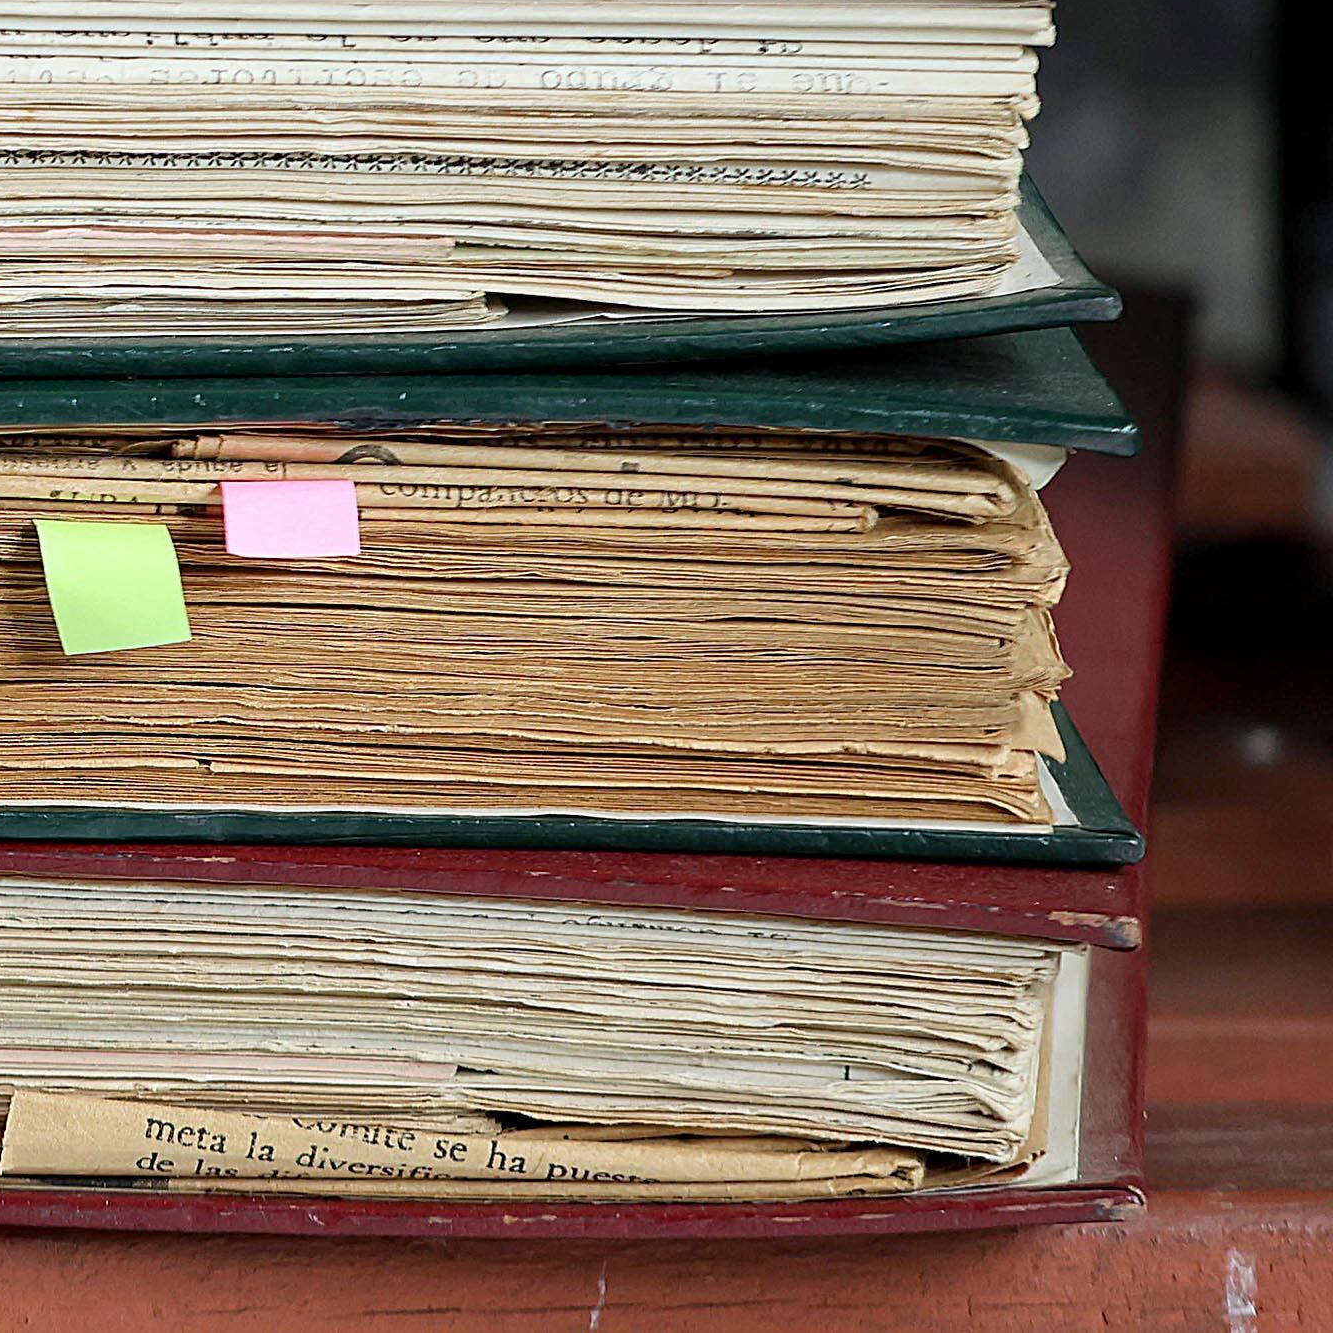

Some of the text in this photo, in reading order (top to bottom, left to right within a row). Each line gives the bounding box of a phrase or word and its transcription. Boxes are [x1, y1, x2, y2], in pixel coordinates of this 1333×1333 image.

[144, 1117, 228, 1154] meta
[244, 1132, 276, 1163] la
[434, 1135, 468, 1162] se
[485, 1139, 527, 1173] ha
[135, 1152, 175, 1172] de
